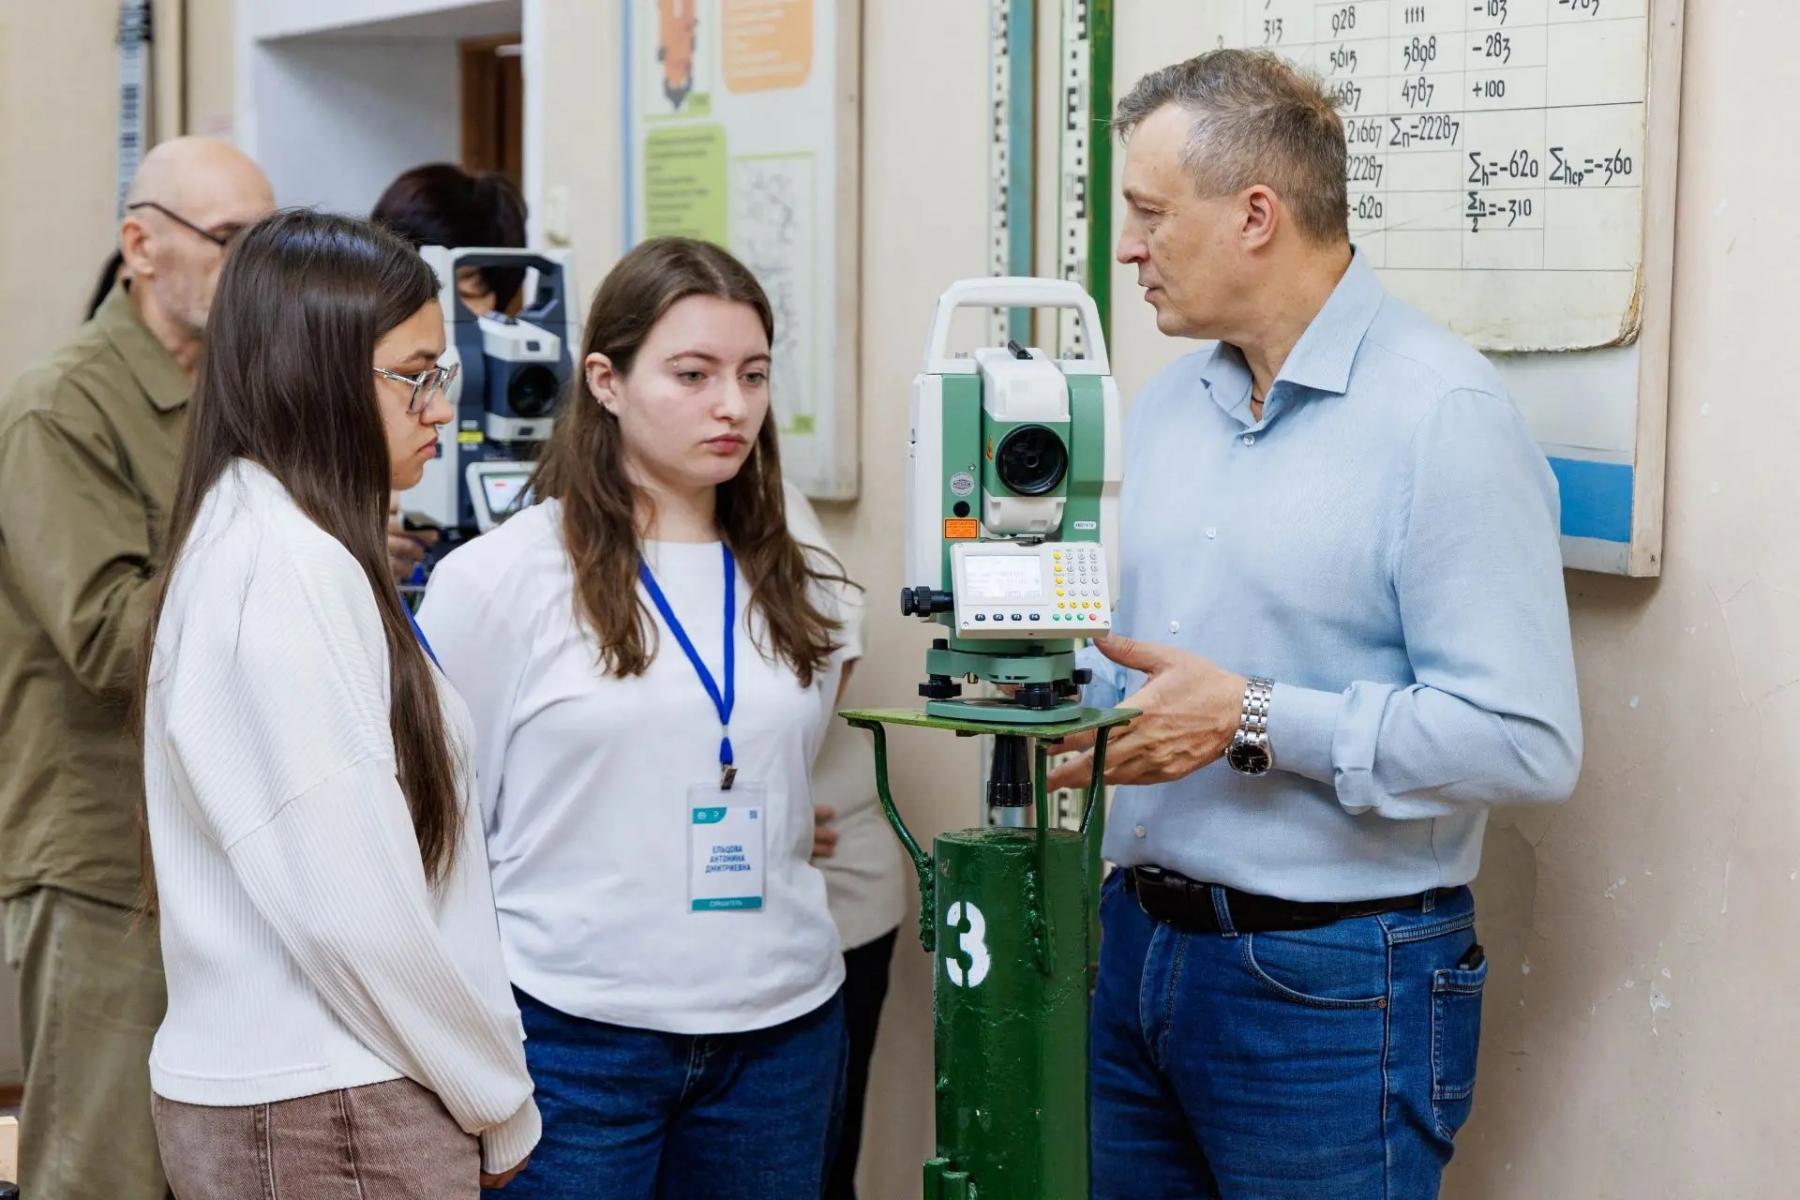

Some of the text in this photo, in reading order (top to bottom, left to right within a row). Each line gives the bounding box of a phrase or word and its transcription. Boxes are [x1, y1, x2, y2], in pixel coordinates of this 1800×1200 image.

[1264, 18, 1283, 44] 313
[1332, 5, 1356, 38] 928
[1404, 6, 1425, 24] 1111
[1330, 43, 1357, 76] 5615
[1403, 35, 1436, 72] 5898
[1472, 31, 1511, 64] -283
[1401, 76, 1434, 109] 4787
[1472, 79, 1505, 98] +100
[1347, 119, 1382, 149] 21667
[945, 901, 991, 988] 3
